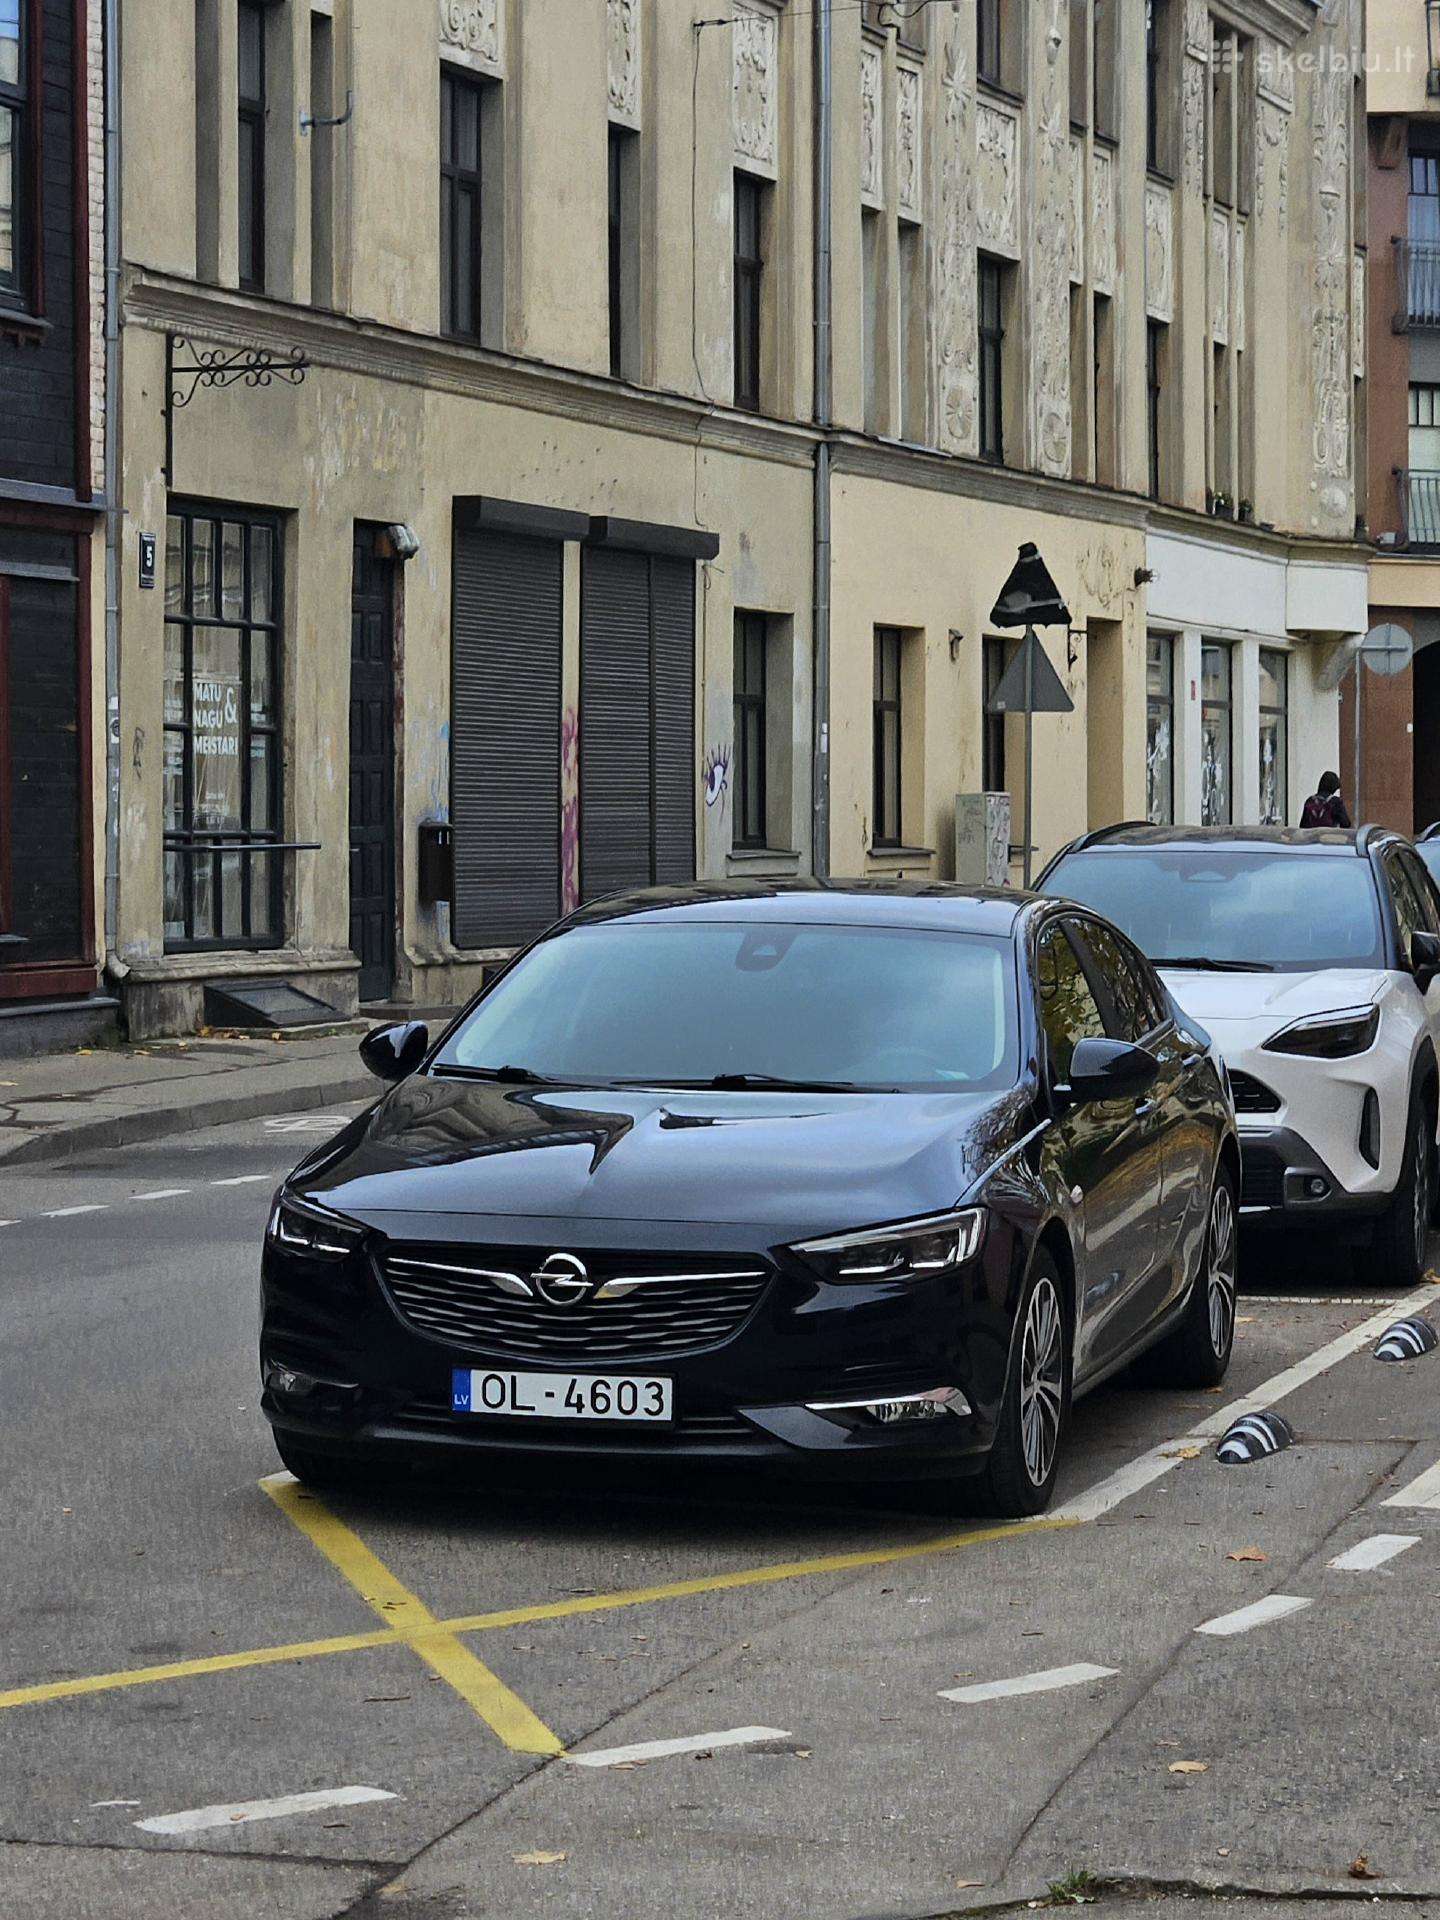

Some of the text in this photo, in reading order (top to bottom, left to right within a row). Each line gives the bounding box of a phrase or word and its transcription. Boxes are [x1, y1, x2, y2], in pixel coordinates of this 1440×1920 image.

[146, 545, 153, 567] 5
[193, 683, 238, 723] MATU &
[193, 709, 223, 728] NAGU
[193, 735, 239, 755] MEISTARI
[454, 1393, 469, 1405] LV
